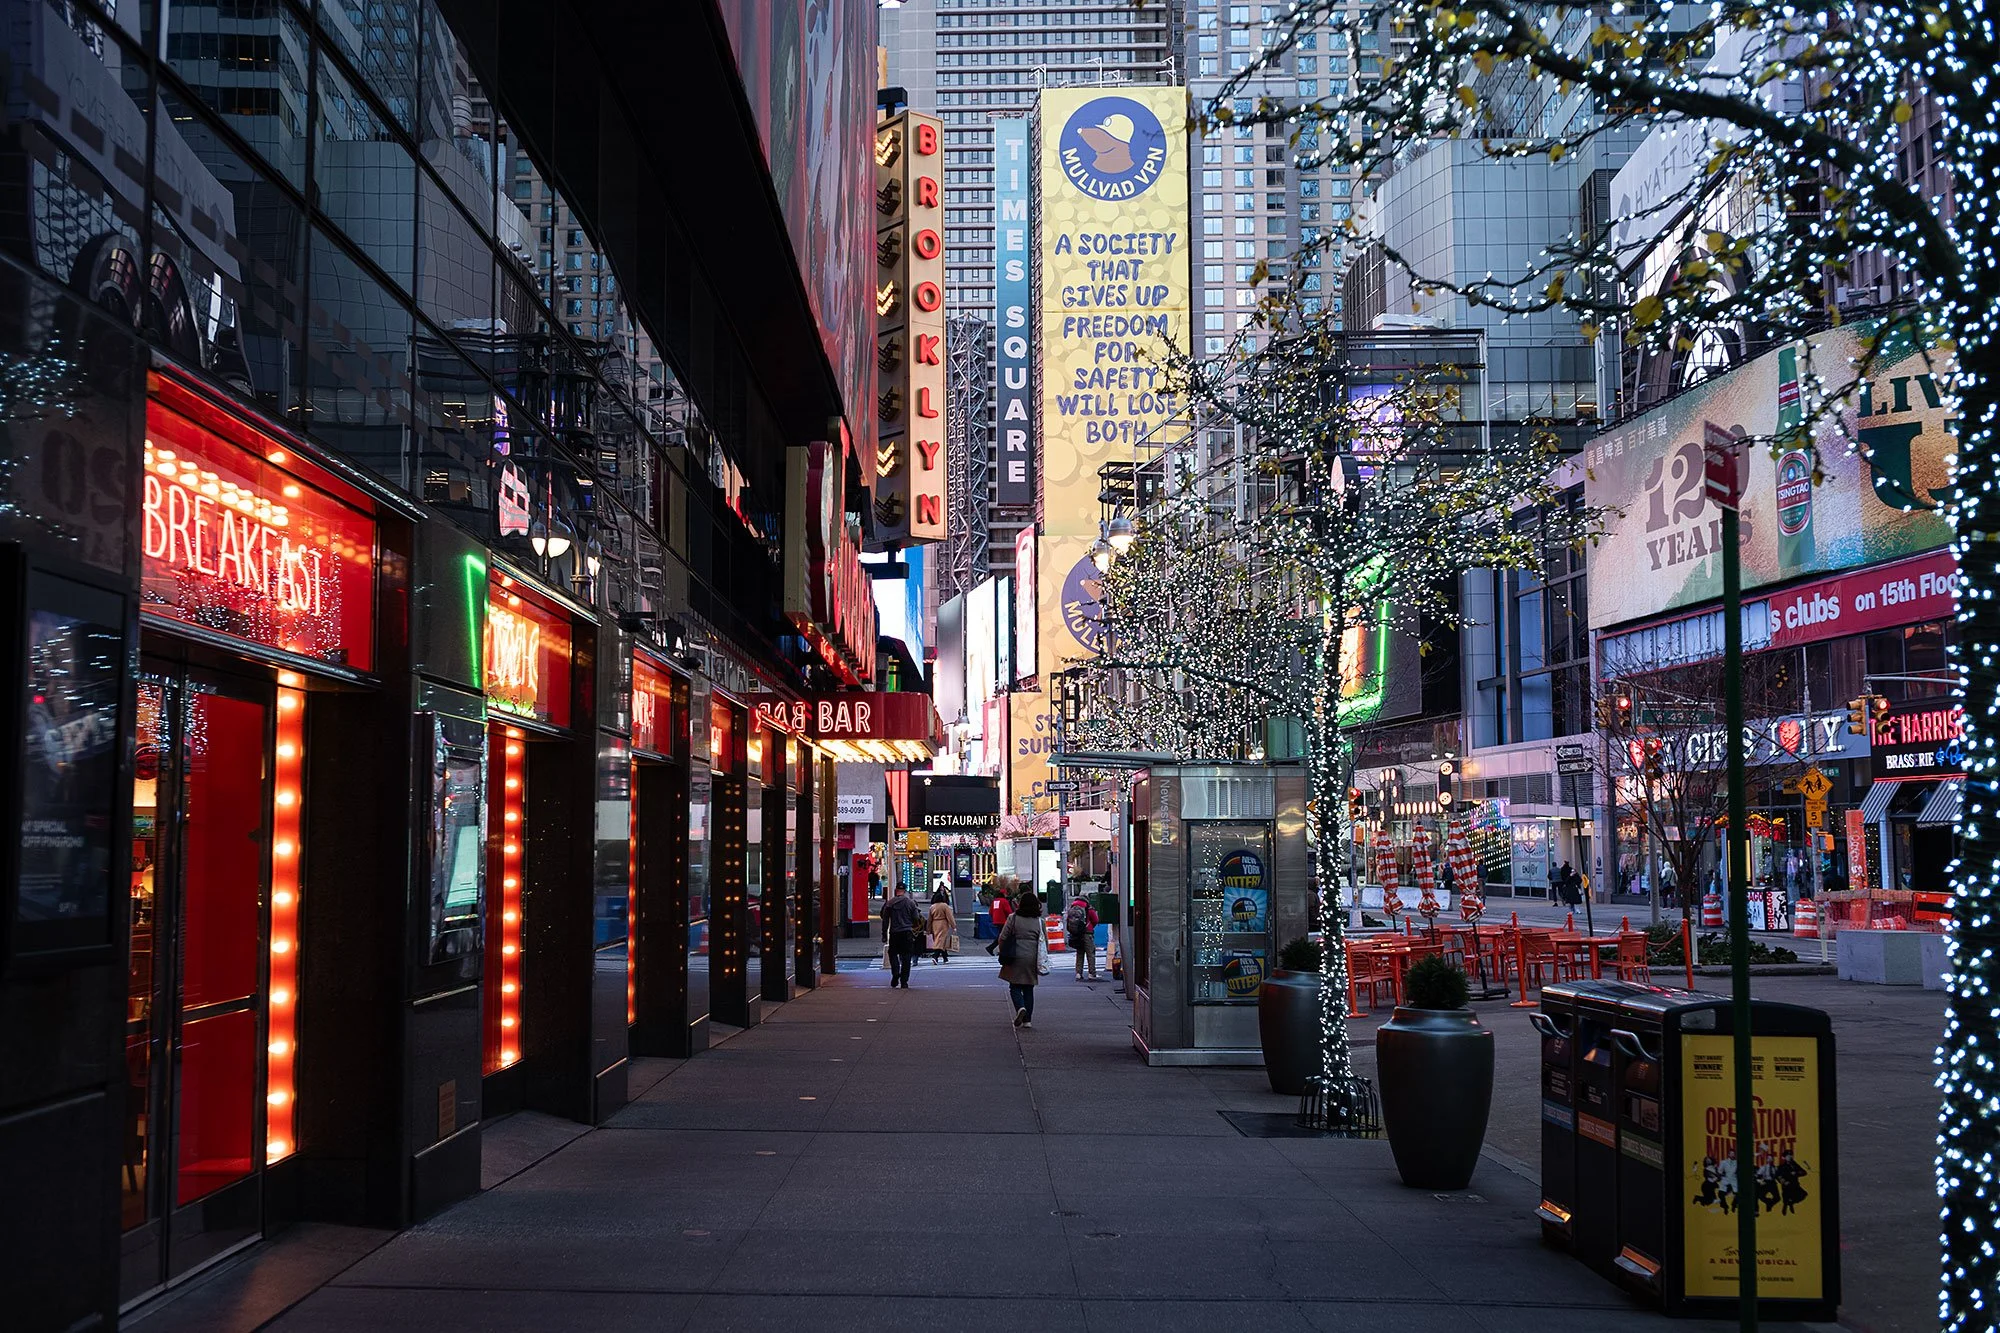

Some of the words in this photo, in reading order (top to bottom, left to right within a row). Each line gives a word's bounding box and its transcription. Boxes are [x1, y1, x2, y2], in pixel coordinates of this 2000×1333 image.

[1062, 147, 1136, 198] MULLVAD
[1134, 146, 1164, 186] VPN
[1635, 145, 1677, 213] HYATT
[1003, 138, 1027, 282] TIMES
[1055, 234, 1071, 255] A
[1078, 233, 1177, 255] SOCIETY
[1087, 259, 1144, 281] THAT
[1062, 284, 1128, 307] GIVES
[1135, 285, 1169, 306] UP
[916, 123, 940, 526] BROOKLYN
[1063, 313, 1168, 339] FREEDOM
[1094, 341, 1138, 364] FOR
[1074, 366, 1159, 390] SAFETY
[1004, 306, 1028, 483] SQUARE
[1056, 393, 1119, 416] WILL
[1128, 392, 1178, 415] LOSE
[948, 388, 957, 439] EAGLE
[1086, 420, 1148, 443] BOTH
[948, 445, 957, 535] AMERICAN
[143, 475, 323, 617] BREAKFAST
[1785, 593, 1840, 630] clubs
[1855, 592, 1875, 612] on
[1879, 578, 1916, 607] 15th
[818, 701, 871, 733] BAR
[924, 814, 988, 826] RESTAURANT
[1160, 780, 1172, 846] Newsstand
[1811, 812, 1818, 821] 5
[1243, 865, 1261, 875] YORK
[1766, 891, 1775, 931] CHICAGO
[1705, 1107, 1796, 1139] OPEATION
